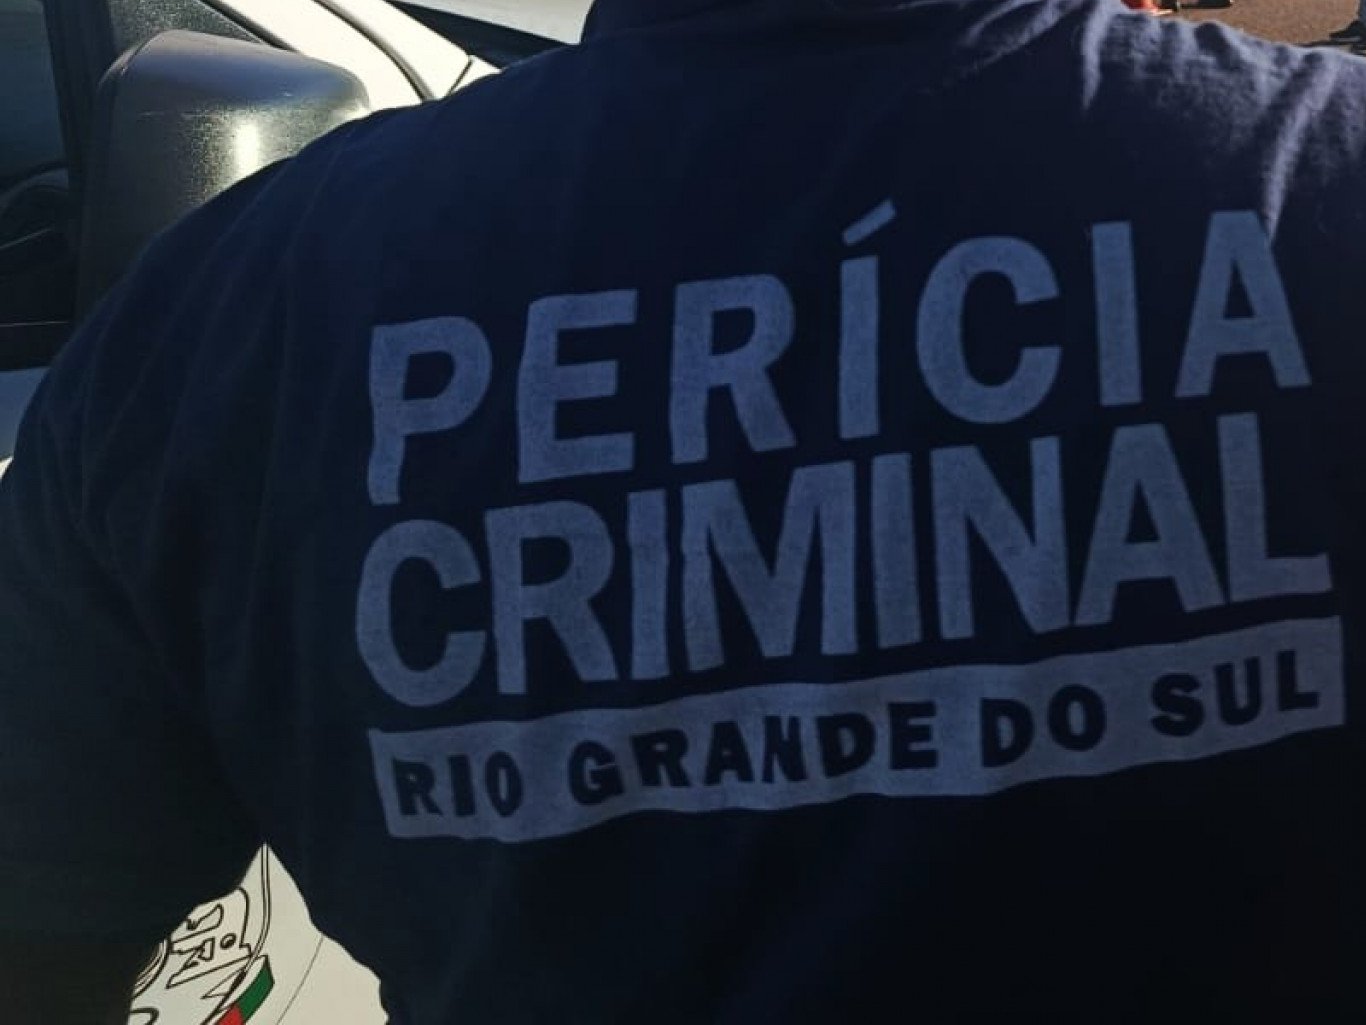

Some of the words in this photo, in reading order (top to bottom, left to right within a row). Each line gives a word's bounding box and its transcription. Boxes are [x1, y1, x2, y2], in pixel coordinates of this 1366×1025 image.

[367, 199, 1311, 506] PERÍCIA
[354, 412, 1332, 707] CRIMINAL
[392, 751, 525, 817] RIO
[567, 701, 938, 807] GRANDE
[980, 684, 1108, 769] DO
[1151, 650, 1319, 737] SUL
